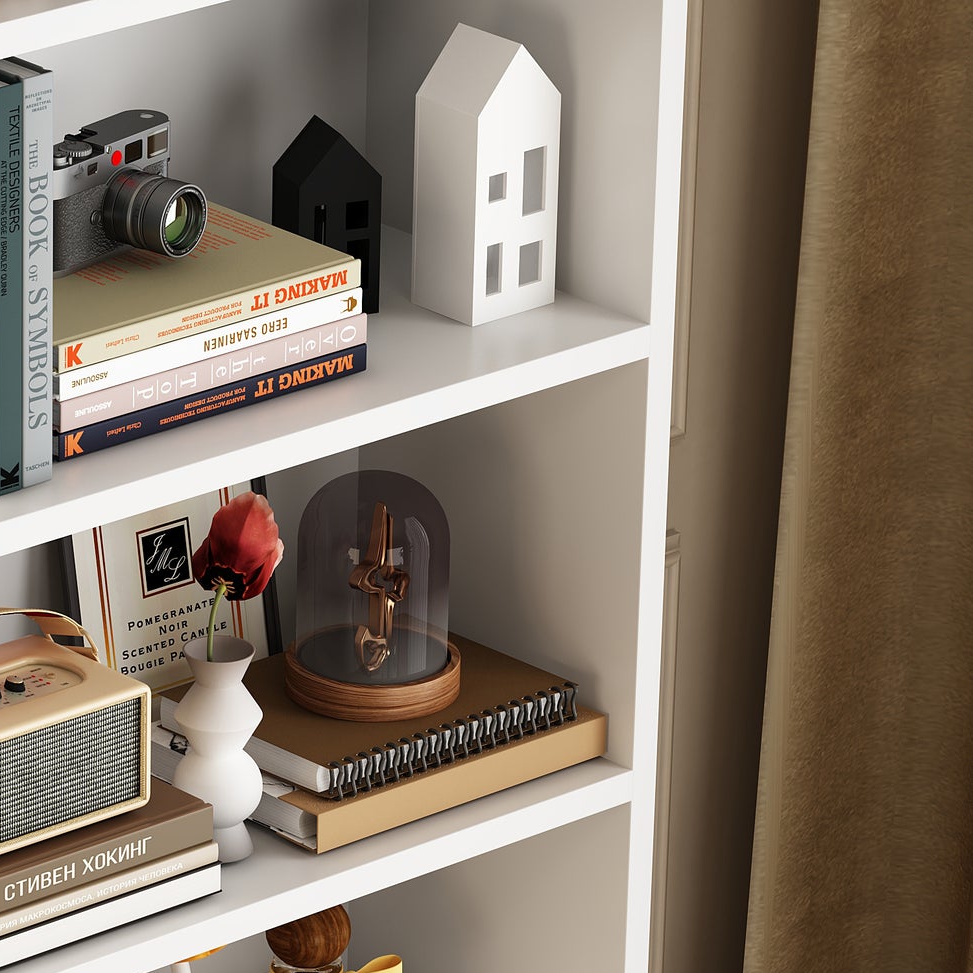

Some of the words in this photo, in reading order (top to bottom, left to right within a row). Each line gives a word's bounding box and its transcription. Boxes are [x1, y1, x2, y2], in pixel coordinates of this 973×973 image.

[9, 105, 20, 158] TEXTILE
[28, 139, 39, 169] THE
[9, 160, 20, 233] DESIGNERS
[28, 172, 49, 259] BOOK
[28, 264, 38, 282] OF
[274, 269, 348, 304] MAKING
[251, 292, 270, 312] IT
[157, 321, 195, 338] TECHNIQUES
[196, 309, 242, 333] MANUFACTURING
[262, 317, 288, 335] EERO
[203, 327, 257, 352] SAARINEN
[288, 325, 357, 354] Over
[28, 287, 48, 430] SYMBOLS
[215, 354, 266, 378] the
[71, 371, 108, 389] ASSOULINE
[278, 353, 354, 390] MAKING
[136, 371, 197, 400] Top
[255, 377, 274, 398] IT
[74, 400, 112, 418] ASSOULINE
[159, 407, 196, 425] TECHNIQUES
[196, 395, 246, 419] MANUFACTURING
[25, 461, 50, 472] TASCHEN
[4, 862, 76, 901] СТИВЕН
[82, 836, 153, 875] ХОКИНГ
[97, 879, 137, 898] ИСТОРИЯ
[139, 862, 184, 882] ЧЕЛОВЕКА
